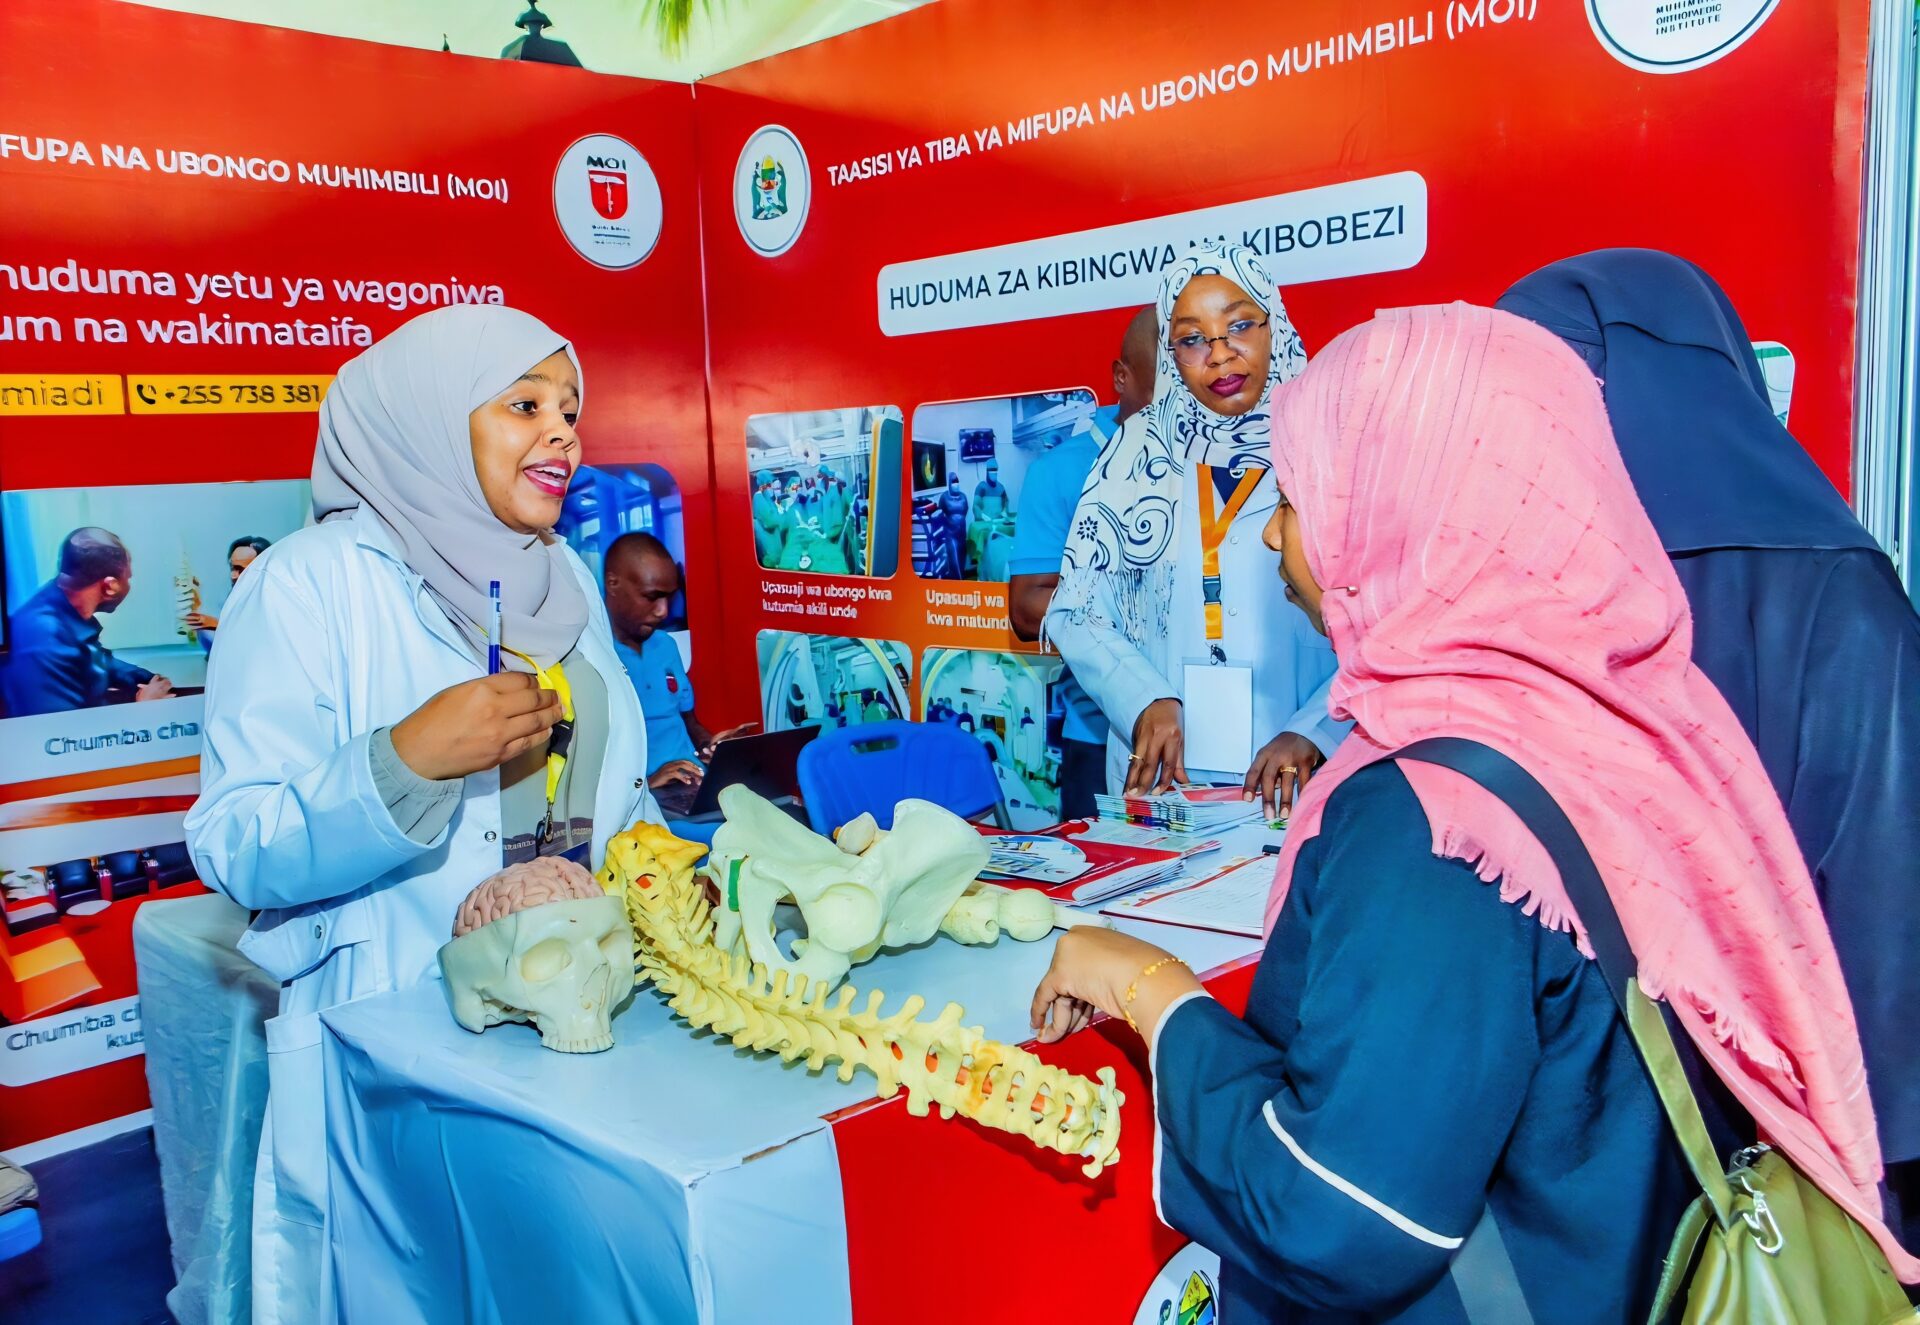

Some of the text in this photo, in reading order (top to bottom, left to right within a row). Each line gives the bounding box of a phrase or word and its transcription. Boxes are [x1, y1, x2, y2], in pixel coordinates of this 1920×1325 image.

[828, 153, 892, 186] TAASISI
[897, 146, 922, 169] YA
[925, 134, 970, 162] TIBA
[975, 126, 1002, 151] YA
[1008, 103, 1094, 144] MIFUPA
[1100, 92, 1135, 122] NA
[1142, 59, 1258, 111] UBONGO
[1268, 12, 1432, 80] MUHIMBILI
[101, 144, 150, 171] NA
[156, 149, 290, 182] UBONGO
[298, 163, 439, 194] MUHIMBILI
[448, 174, 508, 203] (MOI)
[587, 156, 626, 173] MOI
[891, 205, 1403, 309] HUDUMA ZA KIBINGWA KIBOBEZI
[186, 272, 272, 304] yetu
[282, 278, 324, 307] ya
[75, 318, 127, 342] na
[137, 313, 372, 346] wakimataifa
[230, 385, 275, 403] 738
[283, 385, 322, 403] 381
[806, 586, 821, 596] wa
[824, 585, 866, 601] ubongo
[926, 590, 1004, 609] Upasuaji wa
[763, 599, 804, 613] kutumia
[830, 605, 857, 618] unde
[927, 611, 1010, 630] kwa matund
[45, 729, 152, 755] Chumba
[4, 1014, 117, 1050] Chumba
